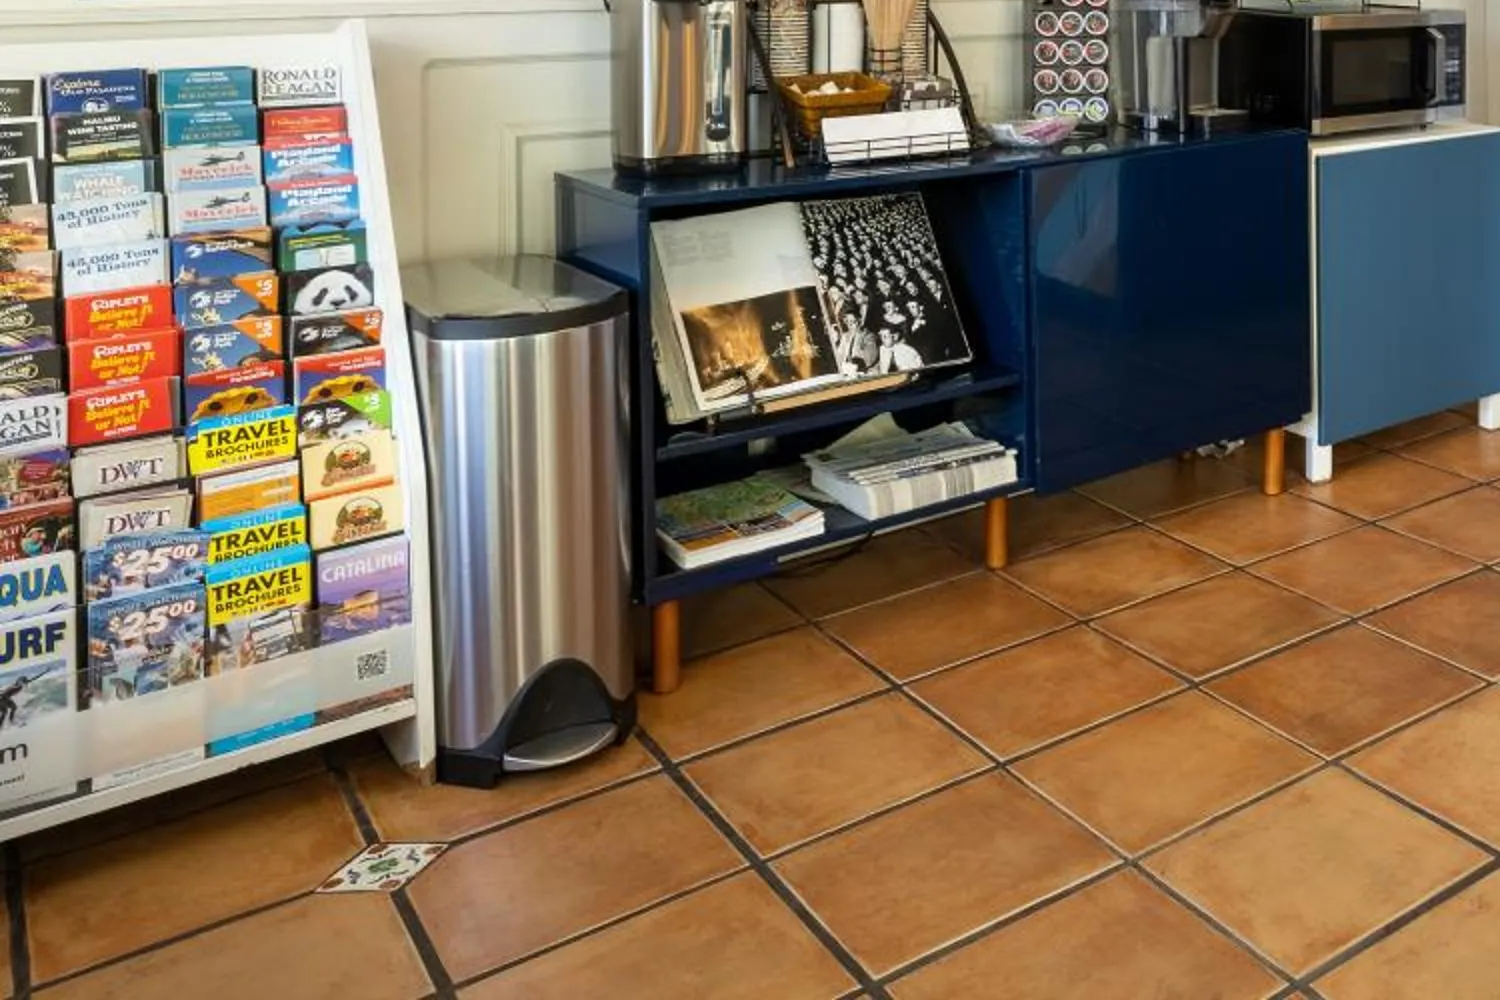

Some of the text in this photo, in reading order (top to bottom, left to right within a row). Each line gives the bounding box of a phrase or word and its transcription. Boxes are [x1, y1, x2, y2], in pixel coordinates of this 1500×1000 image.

[262, 67, 338, 84] RONALD
[262, 80, 338, 96] REAGAN
[203, 417, 291, 449] TRAVEL
[205, 435, 289, 460] BROCHURES
[101, 457, 163, 485] DWT
[107, 509, 171, 535] DWT
[211, 521, 302, 553] TRAVEL
[214, 537, 300, 562] BROCHURES
[319, 550, 407, 584] CATALINA
[211, 567, 303, 601] TRAVEL
[214, 583, 302, 614] BROCHURES
